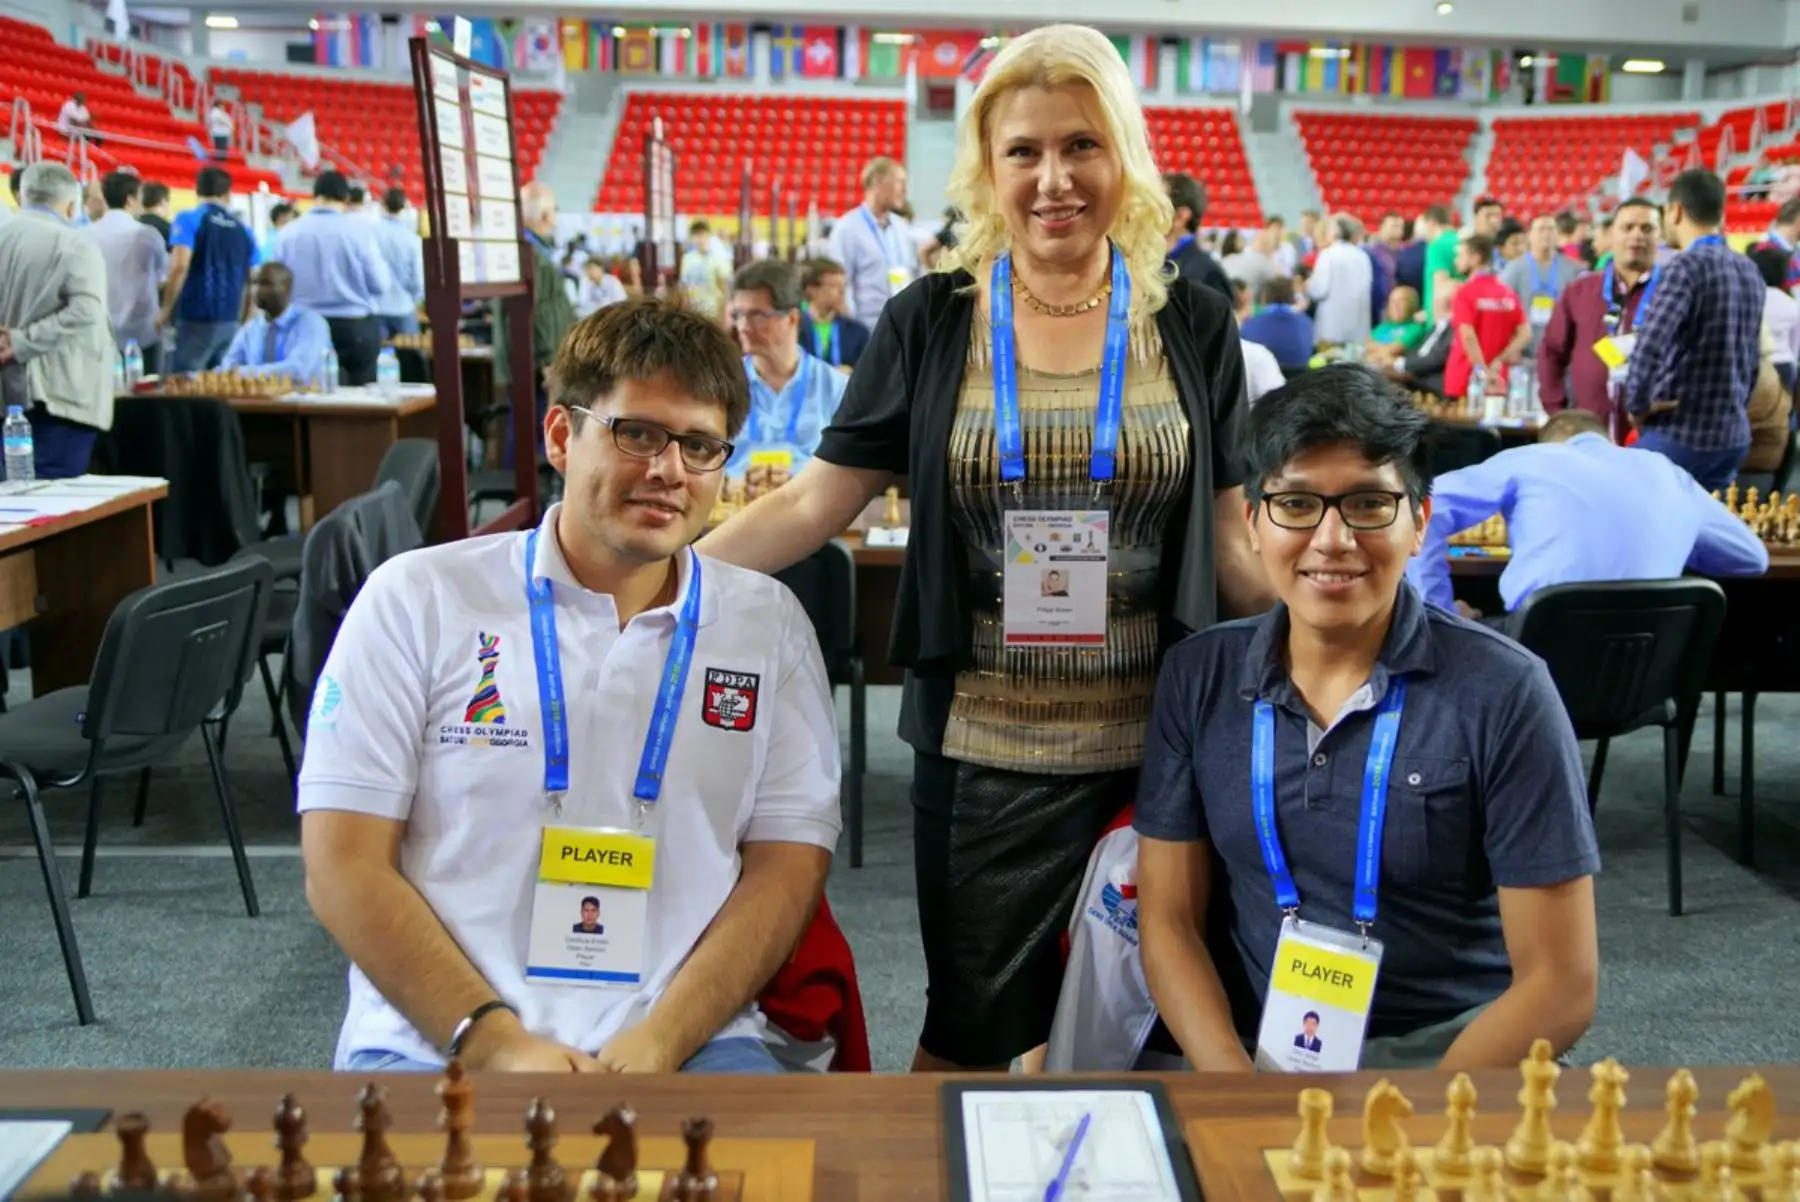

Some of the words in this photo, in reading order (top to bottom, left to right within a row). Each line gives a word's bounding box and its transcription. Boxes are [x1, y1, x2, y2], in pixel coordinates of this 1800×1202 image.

[440, 725, 471, 735] CHESS
[474, 727, 529, 737] OLYMPIAD
[489, 738, 528, 747] GEORGIA
[561, 845, 634, 867] PLAYER
[1291, 958, 1354, 989] PLAYER
